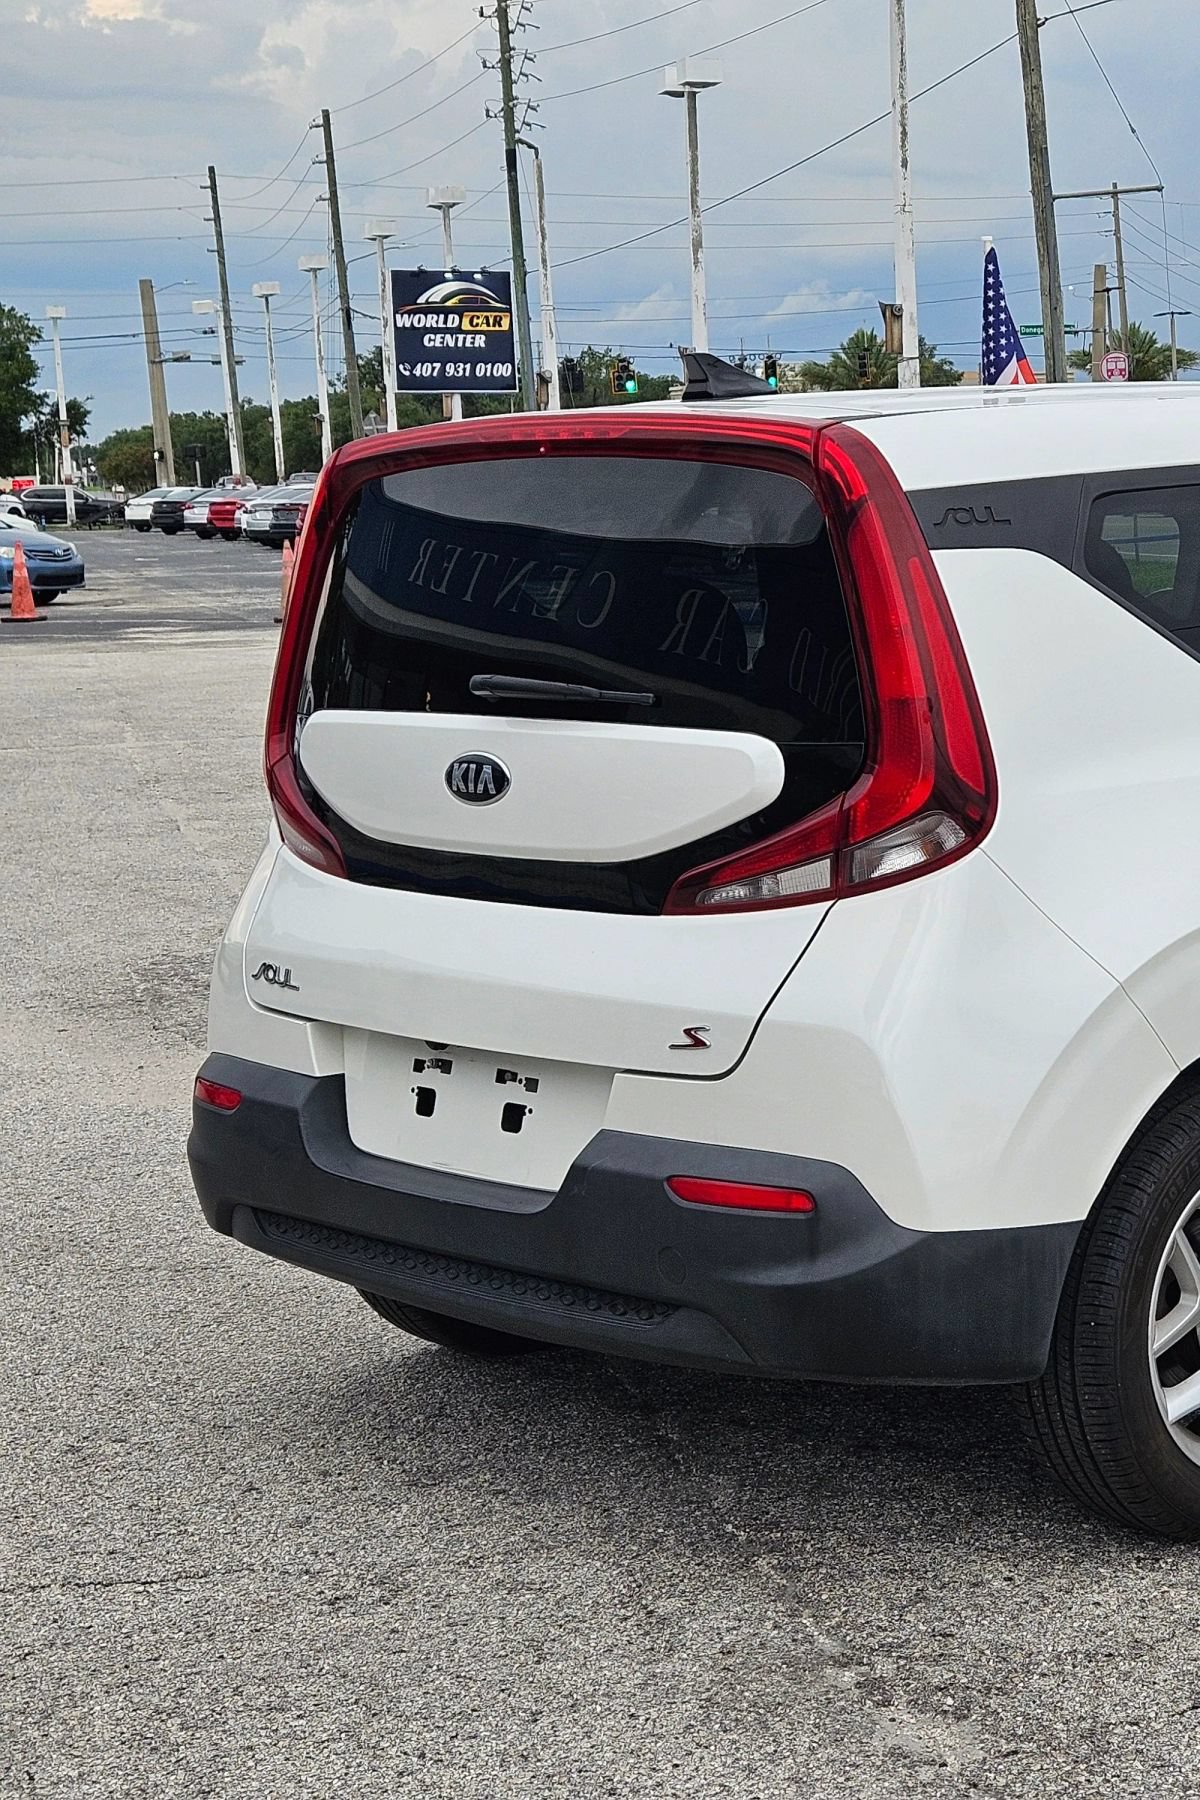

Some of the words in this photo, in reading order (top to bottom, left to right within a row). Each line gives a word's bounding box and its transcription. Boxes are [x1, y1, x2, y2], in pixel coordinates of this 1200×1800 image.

[395, 312, 460, 328] WORLD
[468, 314, 503, 328] CAR
[423, 333, 486, 348] CENTER
[412, 362, 441, 377] 407
[445, 362, 471, 377] 931
[475, 362, 512, 377] 0100
[932, 505, 1012, 526] SOUL
[451, 762, 497, 795] KIA
[251, 961, 300, 992] SOUL
[667, 1024, 712, 1050] S
